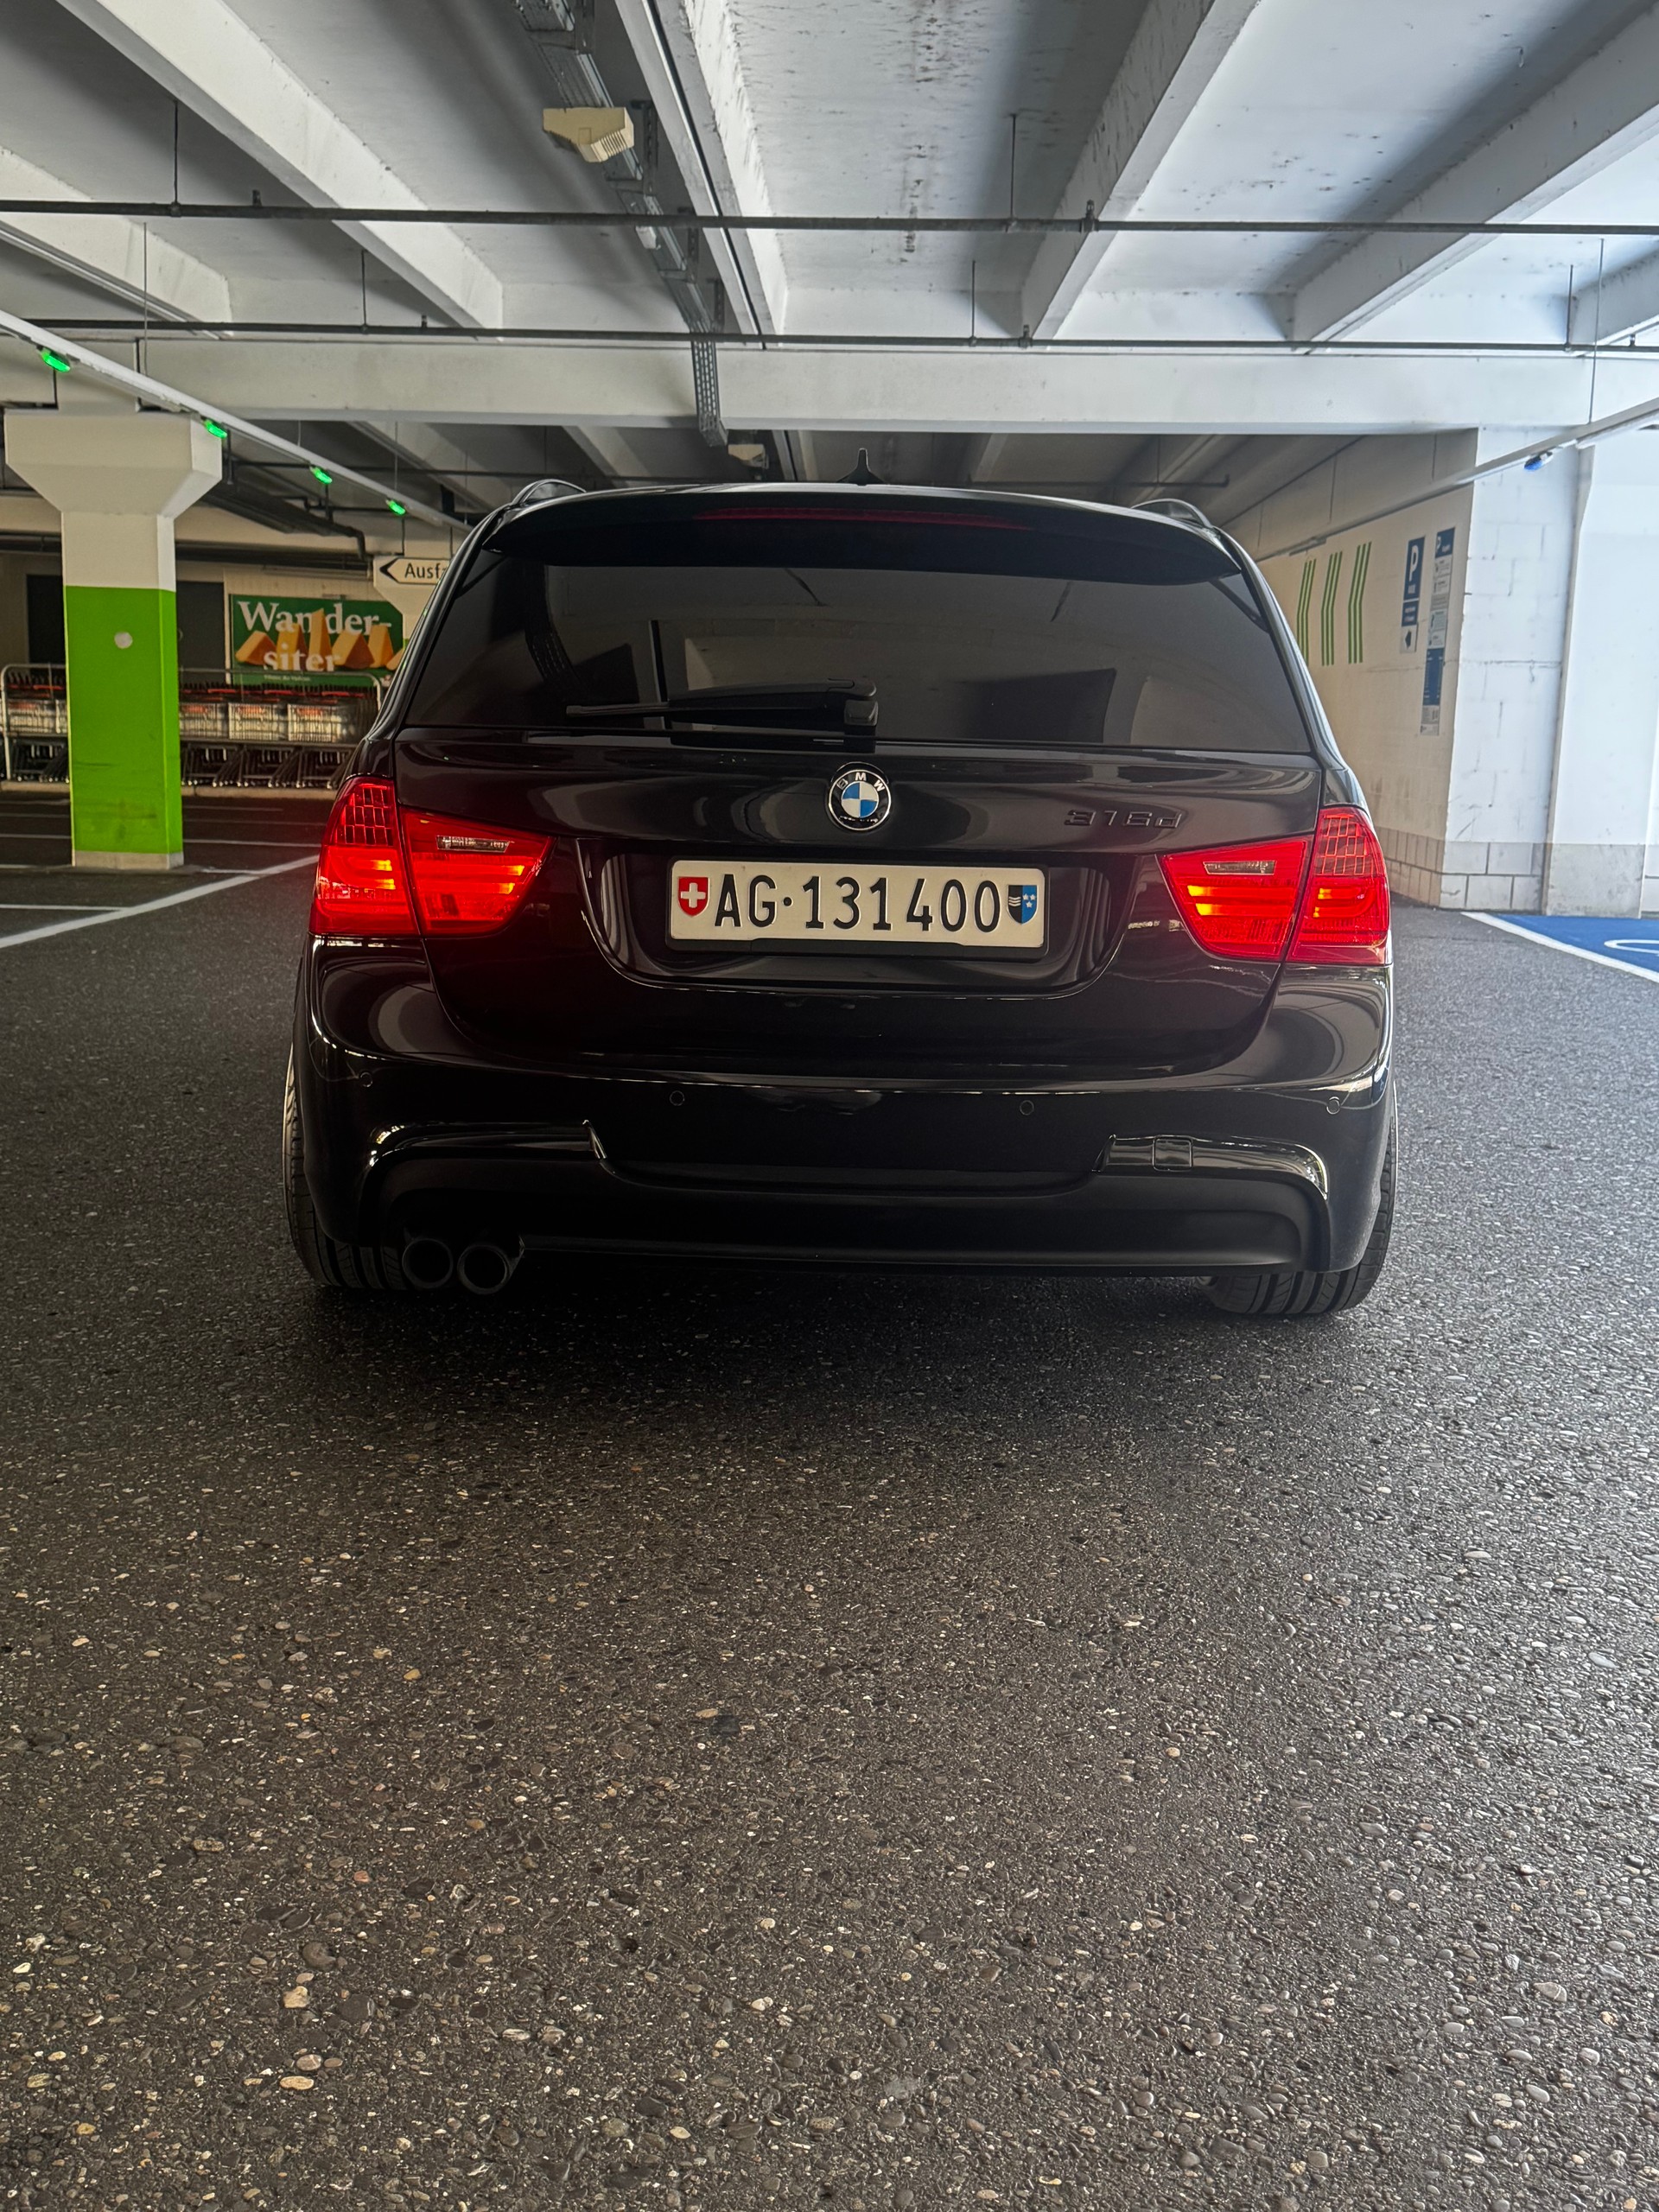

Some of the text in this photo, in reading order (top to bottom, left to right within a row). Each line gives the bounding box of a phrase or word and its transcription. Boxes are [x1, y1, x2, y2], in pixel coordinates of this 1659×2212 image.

[404, 563, 447, 579] Ausf
[1408, 544, 1419, 582] P
[238, 601, 391, 635] Wander-
[836, 772, 886, 792] BMW
